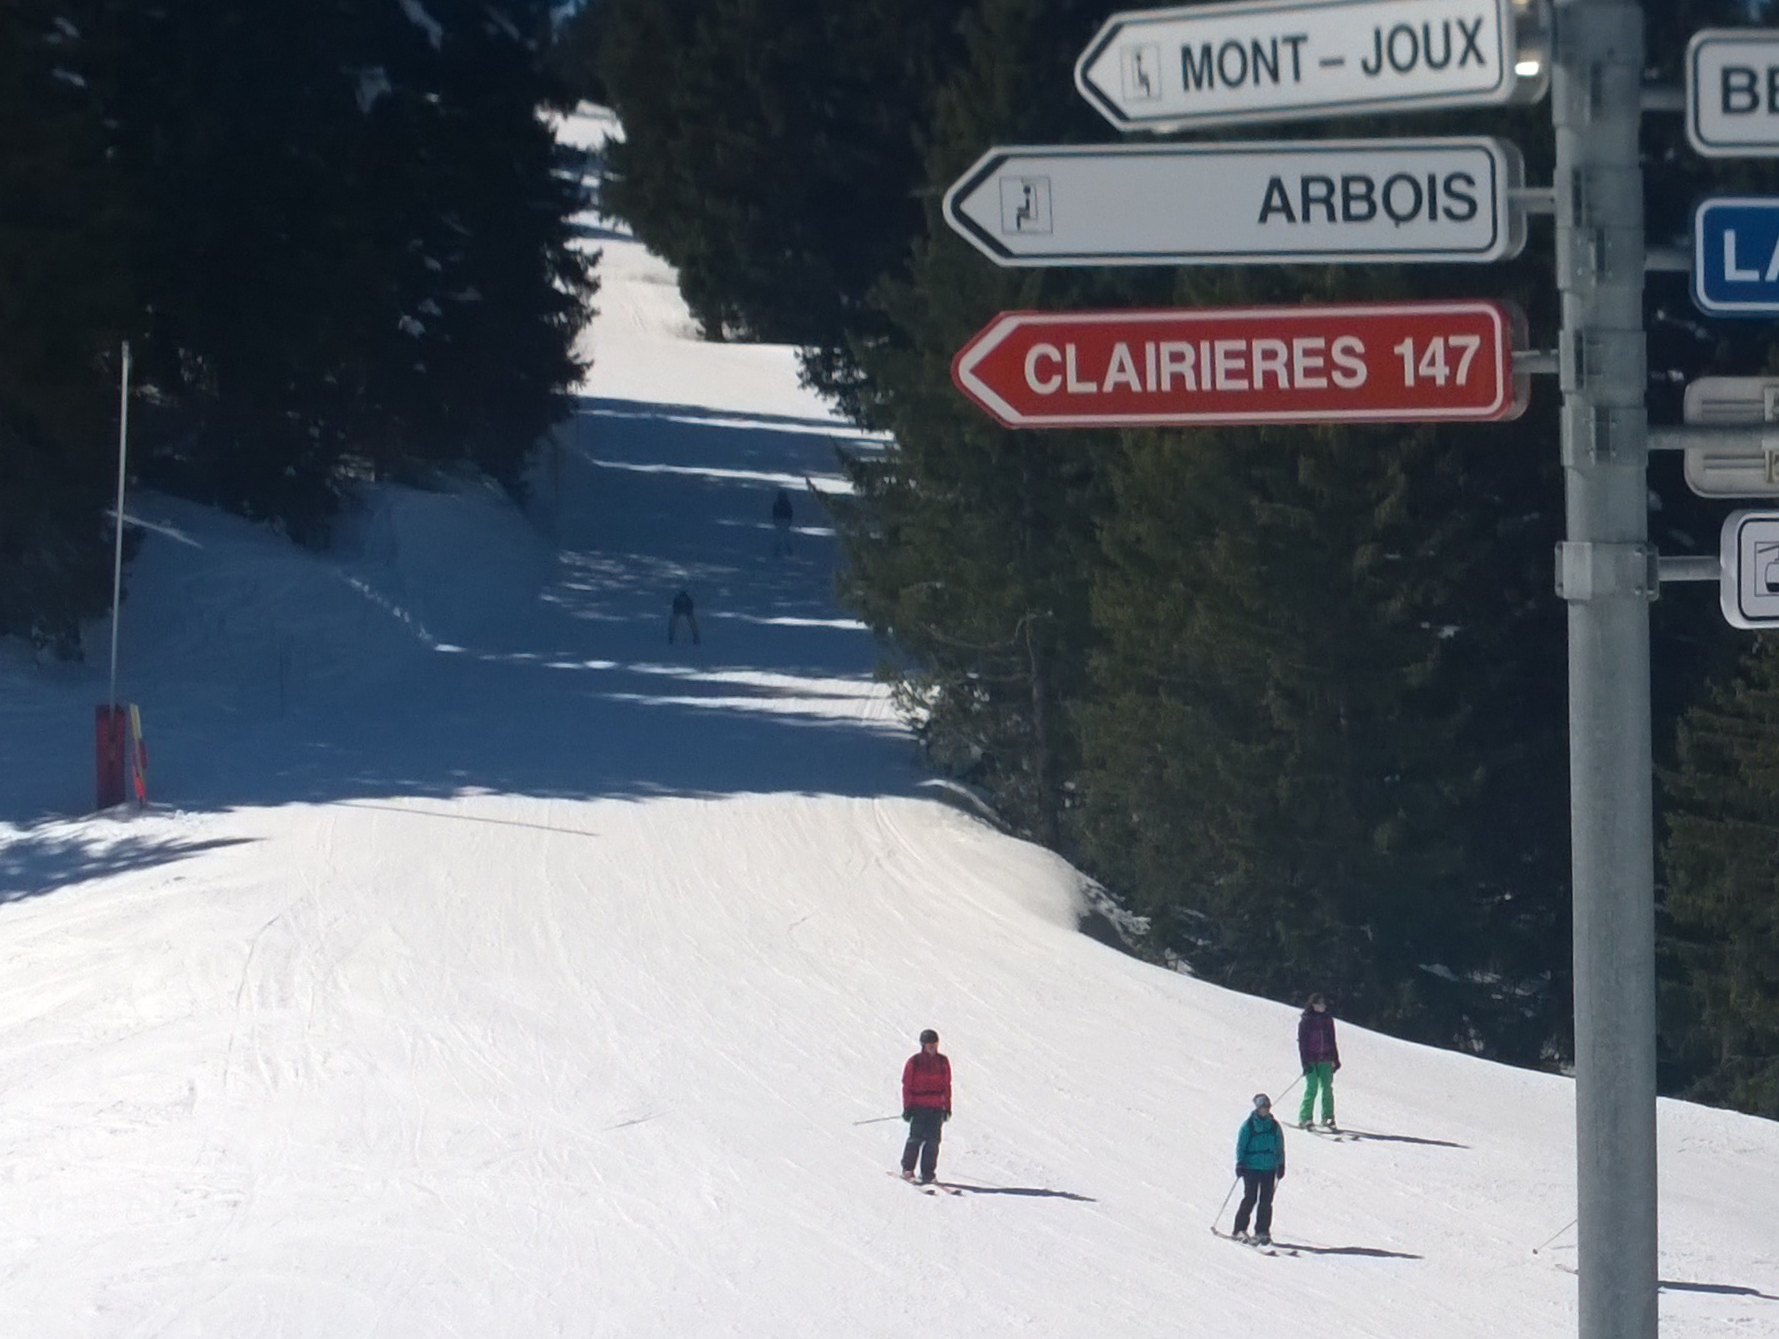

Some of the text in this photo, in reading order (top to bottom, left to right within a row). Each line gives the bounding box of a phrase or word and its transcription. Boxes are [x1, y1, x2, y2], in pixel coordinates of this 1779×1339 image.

[1180, 33, 1308, 93] MONT
[1360, 17, 1487, 78] JOUX
[1258, 172, 1479, 225] ARBOIS
[1024, 335, 1482, 394] CLAIRIERES 147
